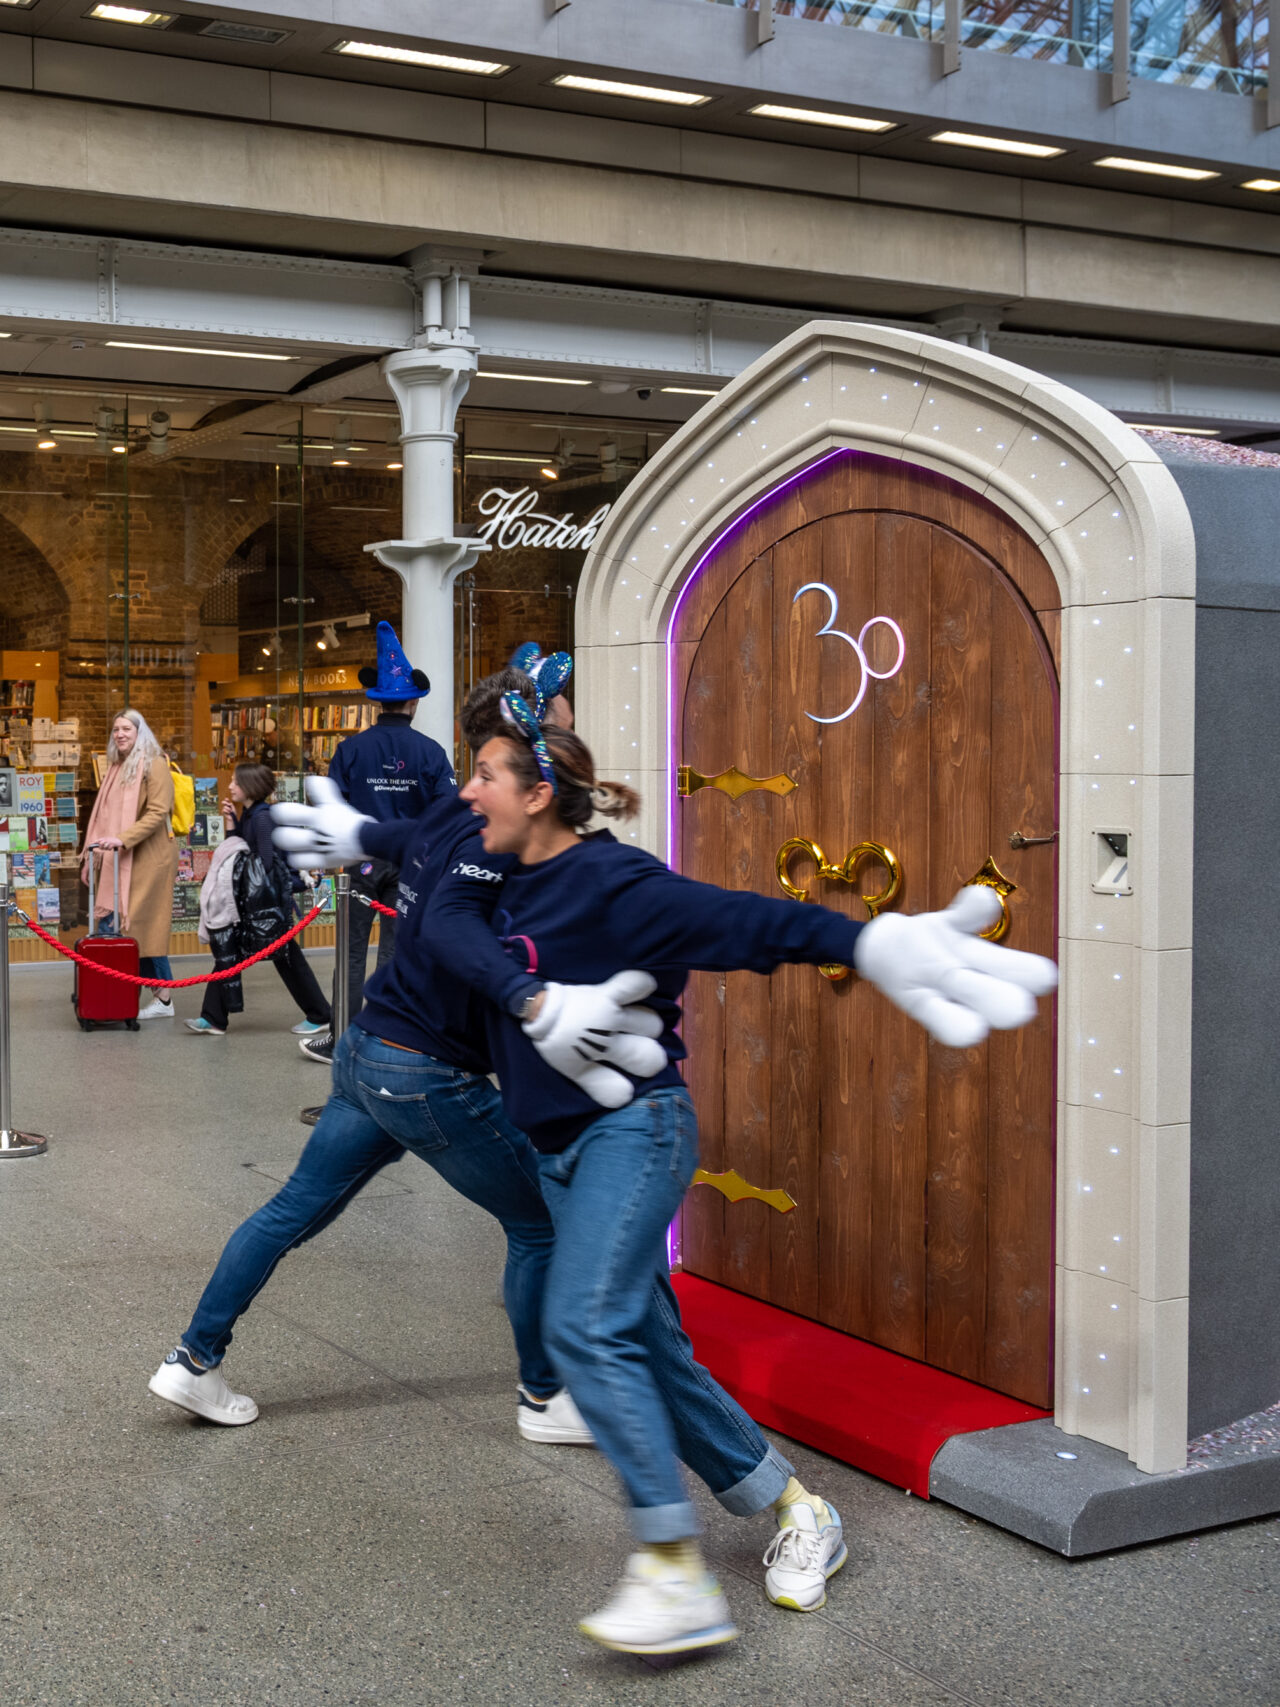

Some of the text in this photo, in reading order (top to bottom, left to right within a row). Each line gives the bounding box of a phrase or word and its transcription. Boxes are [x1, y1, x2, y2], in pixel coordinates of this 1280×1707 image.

[792, 582, 906, 724] 30
[288, 672, 347, 687] NEW BOOKS
[19, 777, 42, 786] ROY
[21, 802, 43, 812] 1960
